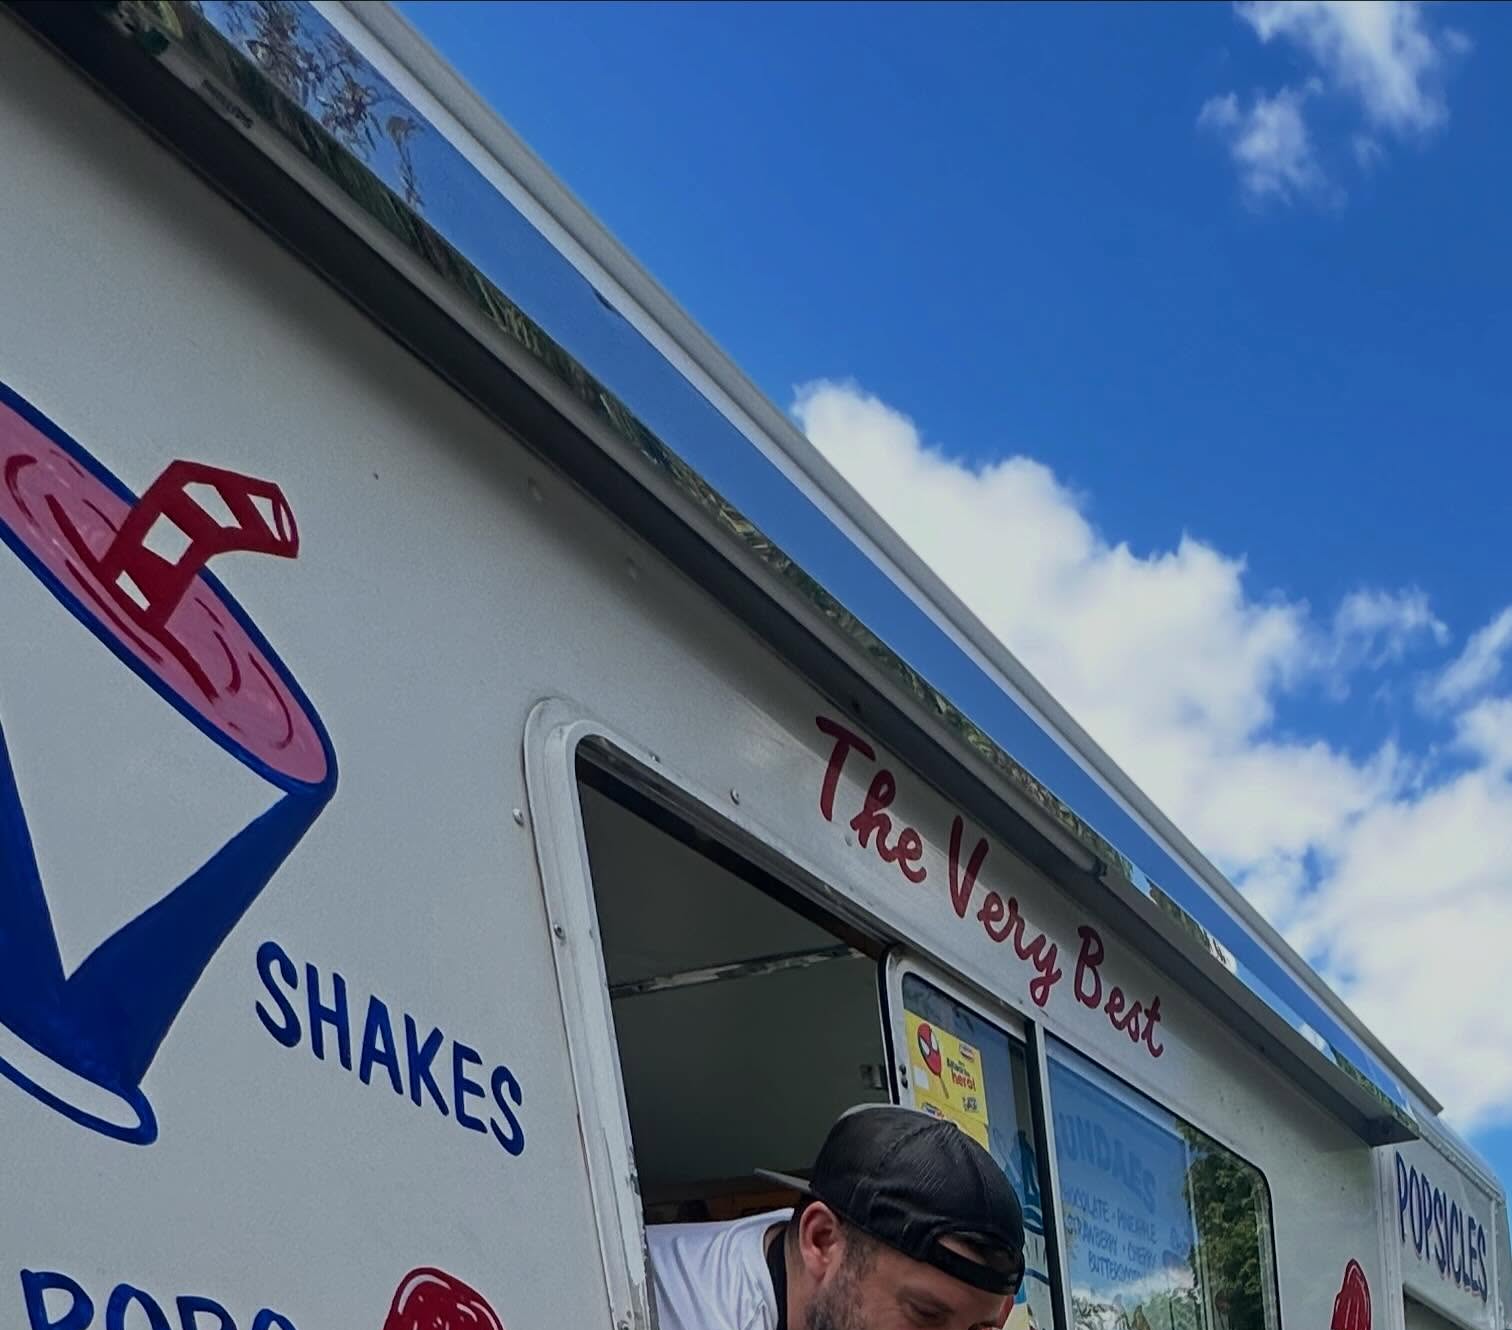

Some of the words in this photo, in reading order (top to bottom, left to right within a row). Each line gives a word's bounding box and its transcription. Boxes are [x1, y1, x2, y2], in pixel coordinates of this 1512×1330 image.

[816, 716, 927, 884] The
[948, 815, 1062, 1007] Very
[1073, 925, 1164, 1058] Best
[255, 941, 526, 1157] SHAKES
[1396, 1151, 1488, 1304] POPSICLES
